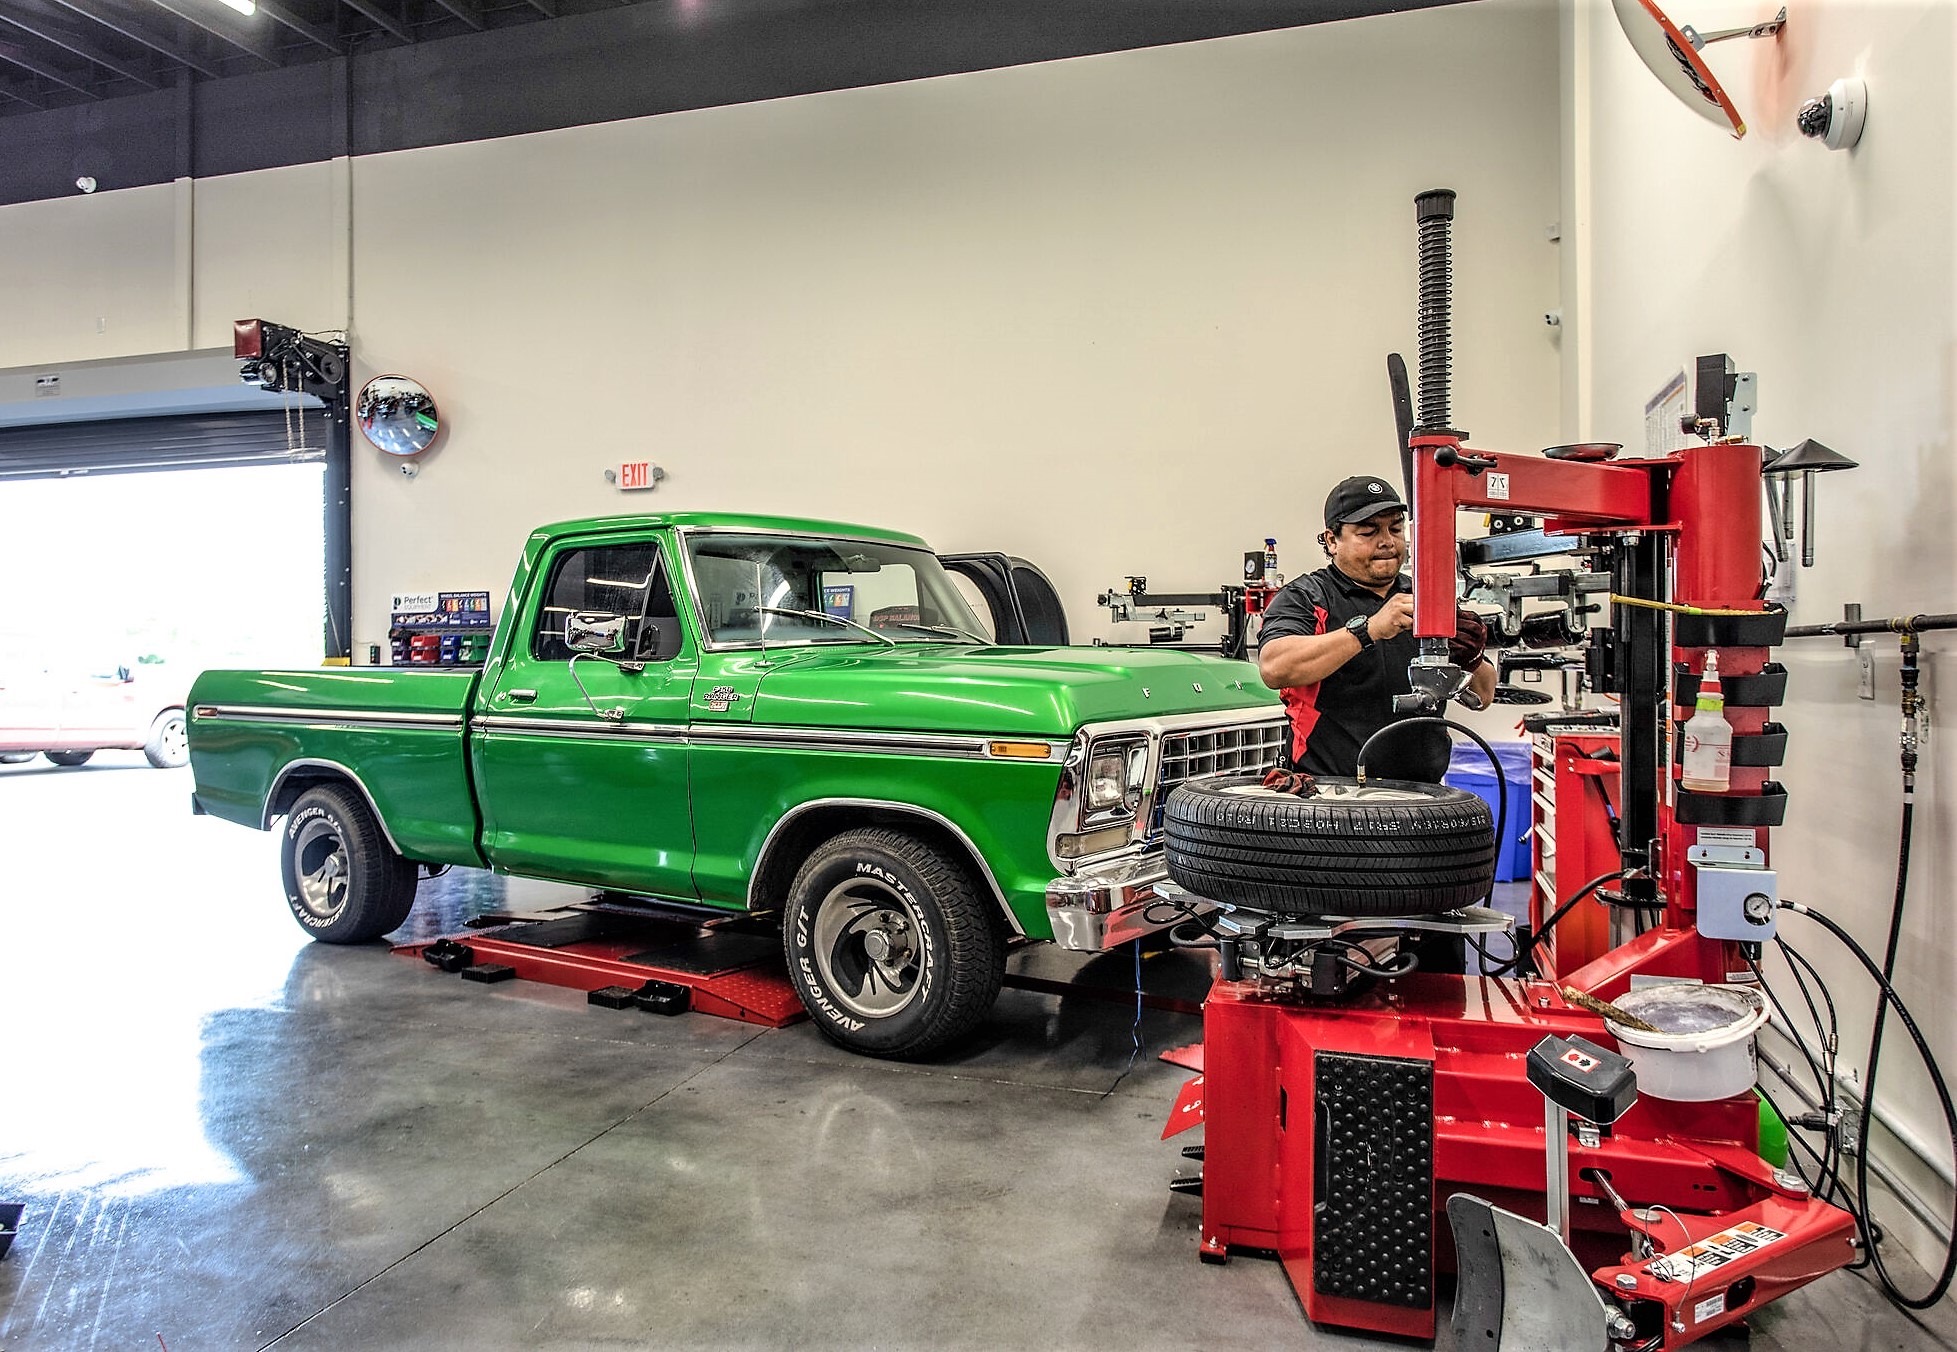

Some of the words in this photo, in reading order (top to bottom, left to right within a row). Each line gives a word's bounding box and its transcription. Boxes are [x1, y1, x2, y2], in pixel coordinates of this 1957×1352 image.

[622, 463, 648, 487] EXIT
[404, 595, 432, 605] Perfect
[1142, 680, 1243, 699] FOR
[288, 807, 325, 840] AVENGER
[796, 905, 811, 948] G/T
[856, 862, 934, 1004] MASTERCRAFT
[800, 956, 866, 1032] AVENGER
